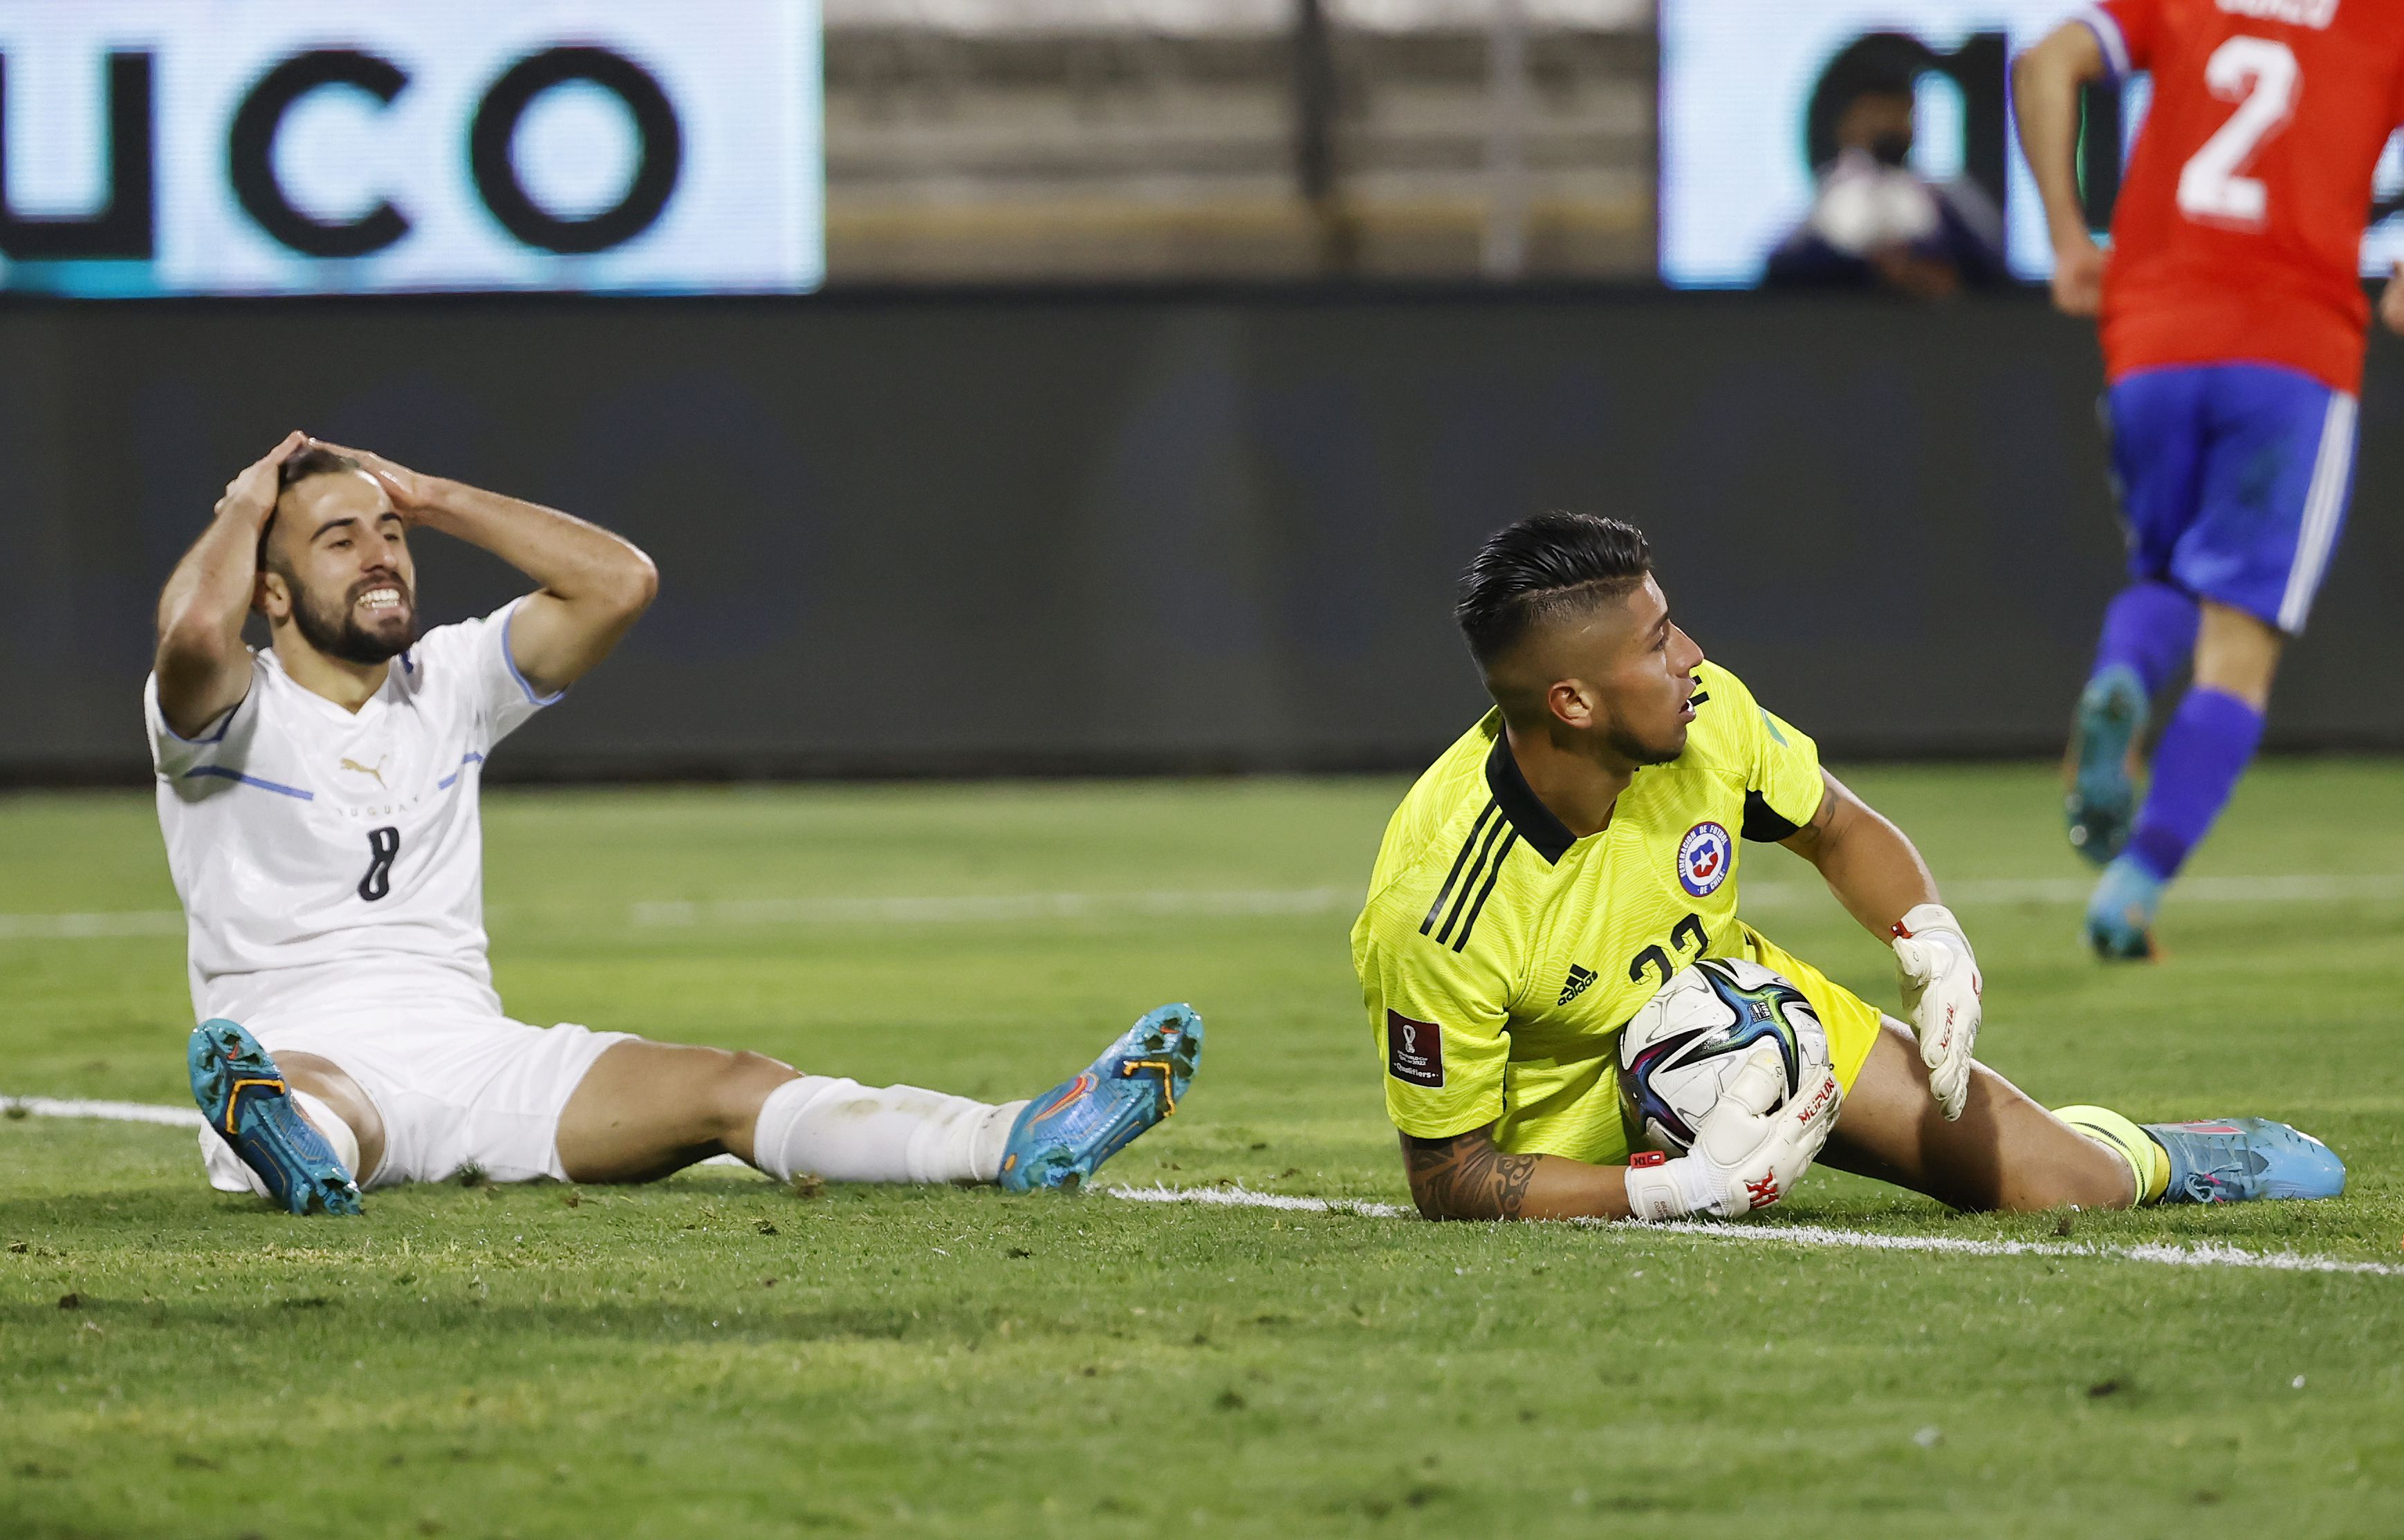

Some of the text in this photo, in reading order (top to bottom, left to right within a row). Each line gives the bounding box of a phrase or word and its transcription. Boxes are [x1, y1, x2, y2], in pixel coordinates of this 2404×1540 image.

[2178, 35, 2301, 223] 2
[358, 826, 400, 902] 8
[1679, 831, 1697, 878] FEDERACION
[1699, 824, 1708, 834] DE
[1699, 871, 1726, 895] DE CHILE
[1557, 970, 1598, 1006] adidas
